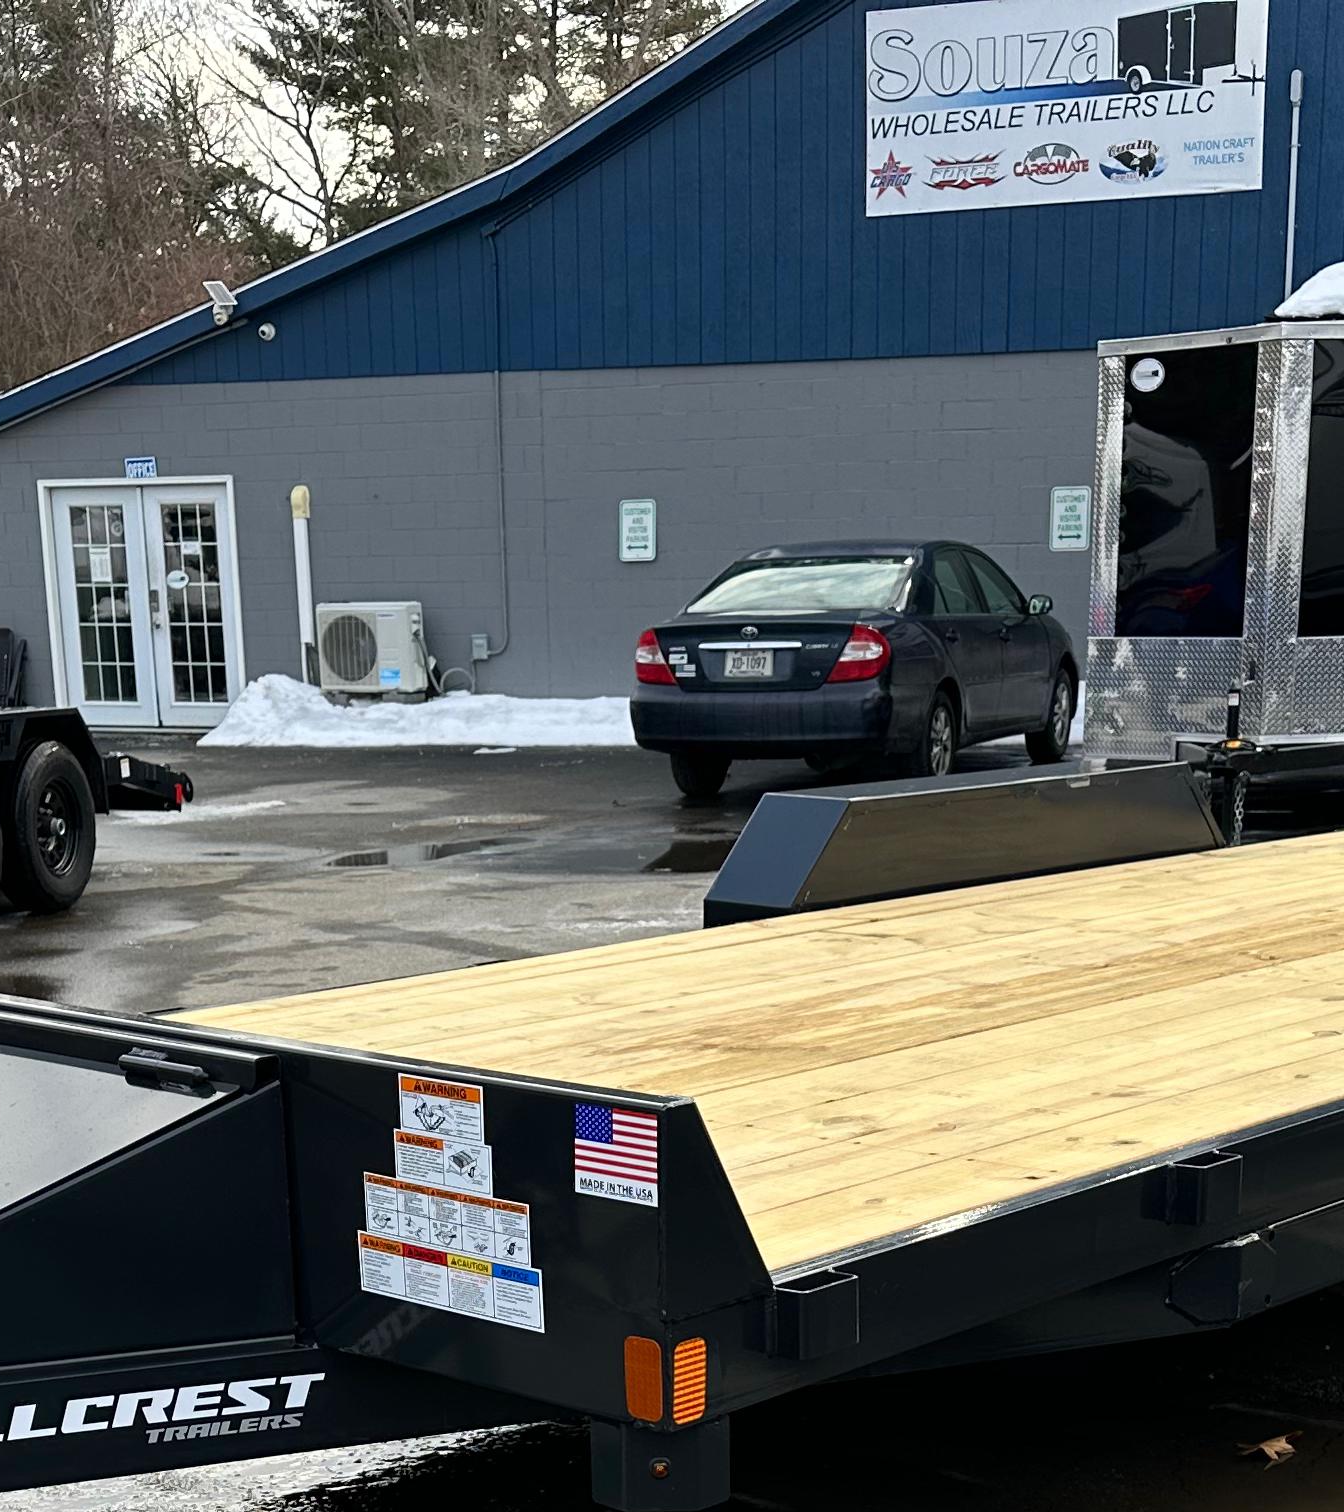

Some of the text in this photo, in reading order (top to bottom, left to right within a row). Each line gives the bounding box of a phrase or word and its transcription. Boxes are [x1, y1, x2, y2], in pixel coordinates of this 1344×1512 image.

[868, 26, 1115, 102] Souza
[871, 90, 1215, 140] WHOLESALE TRAILERS LLC
[1183, 136, 1256, 152] NATION CRAFT
[870, 173, 913, 188] CARGO
[421, 1081, 467, 1099] WARNING
[580, 1177, 605, 1190] MADE
[606, 1182, 616, 1193] IN
[617, 1184, 634, 1196] THE
[636, 1187, 654, 1200] USA
[457, 1258, 489, 1273] CAUTION
[145, 1412, 305, 1445] TRAILERS
